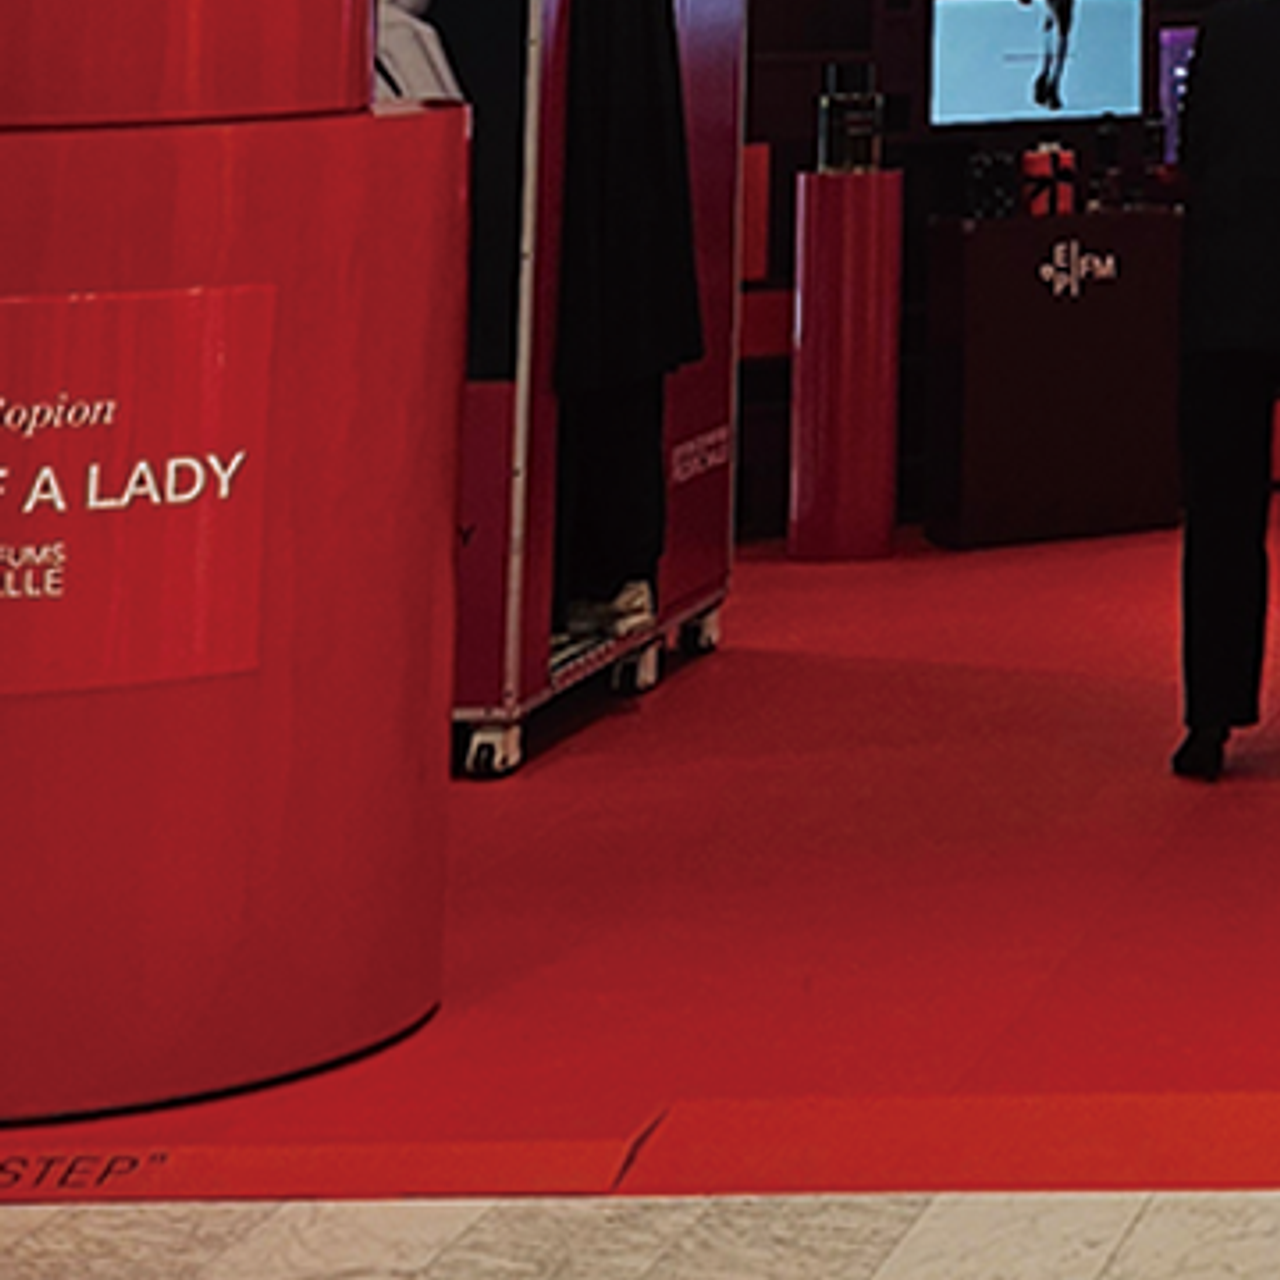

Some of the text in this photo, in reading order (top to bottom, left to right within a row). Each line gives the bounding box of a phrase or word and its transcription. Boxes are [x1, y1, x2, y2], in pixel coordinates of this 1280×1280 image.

[21, 466, 67, 514] A
[85, 450, 247, 510] LADY
[0, 568, 63, 598] LLE
